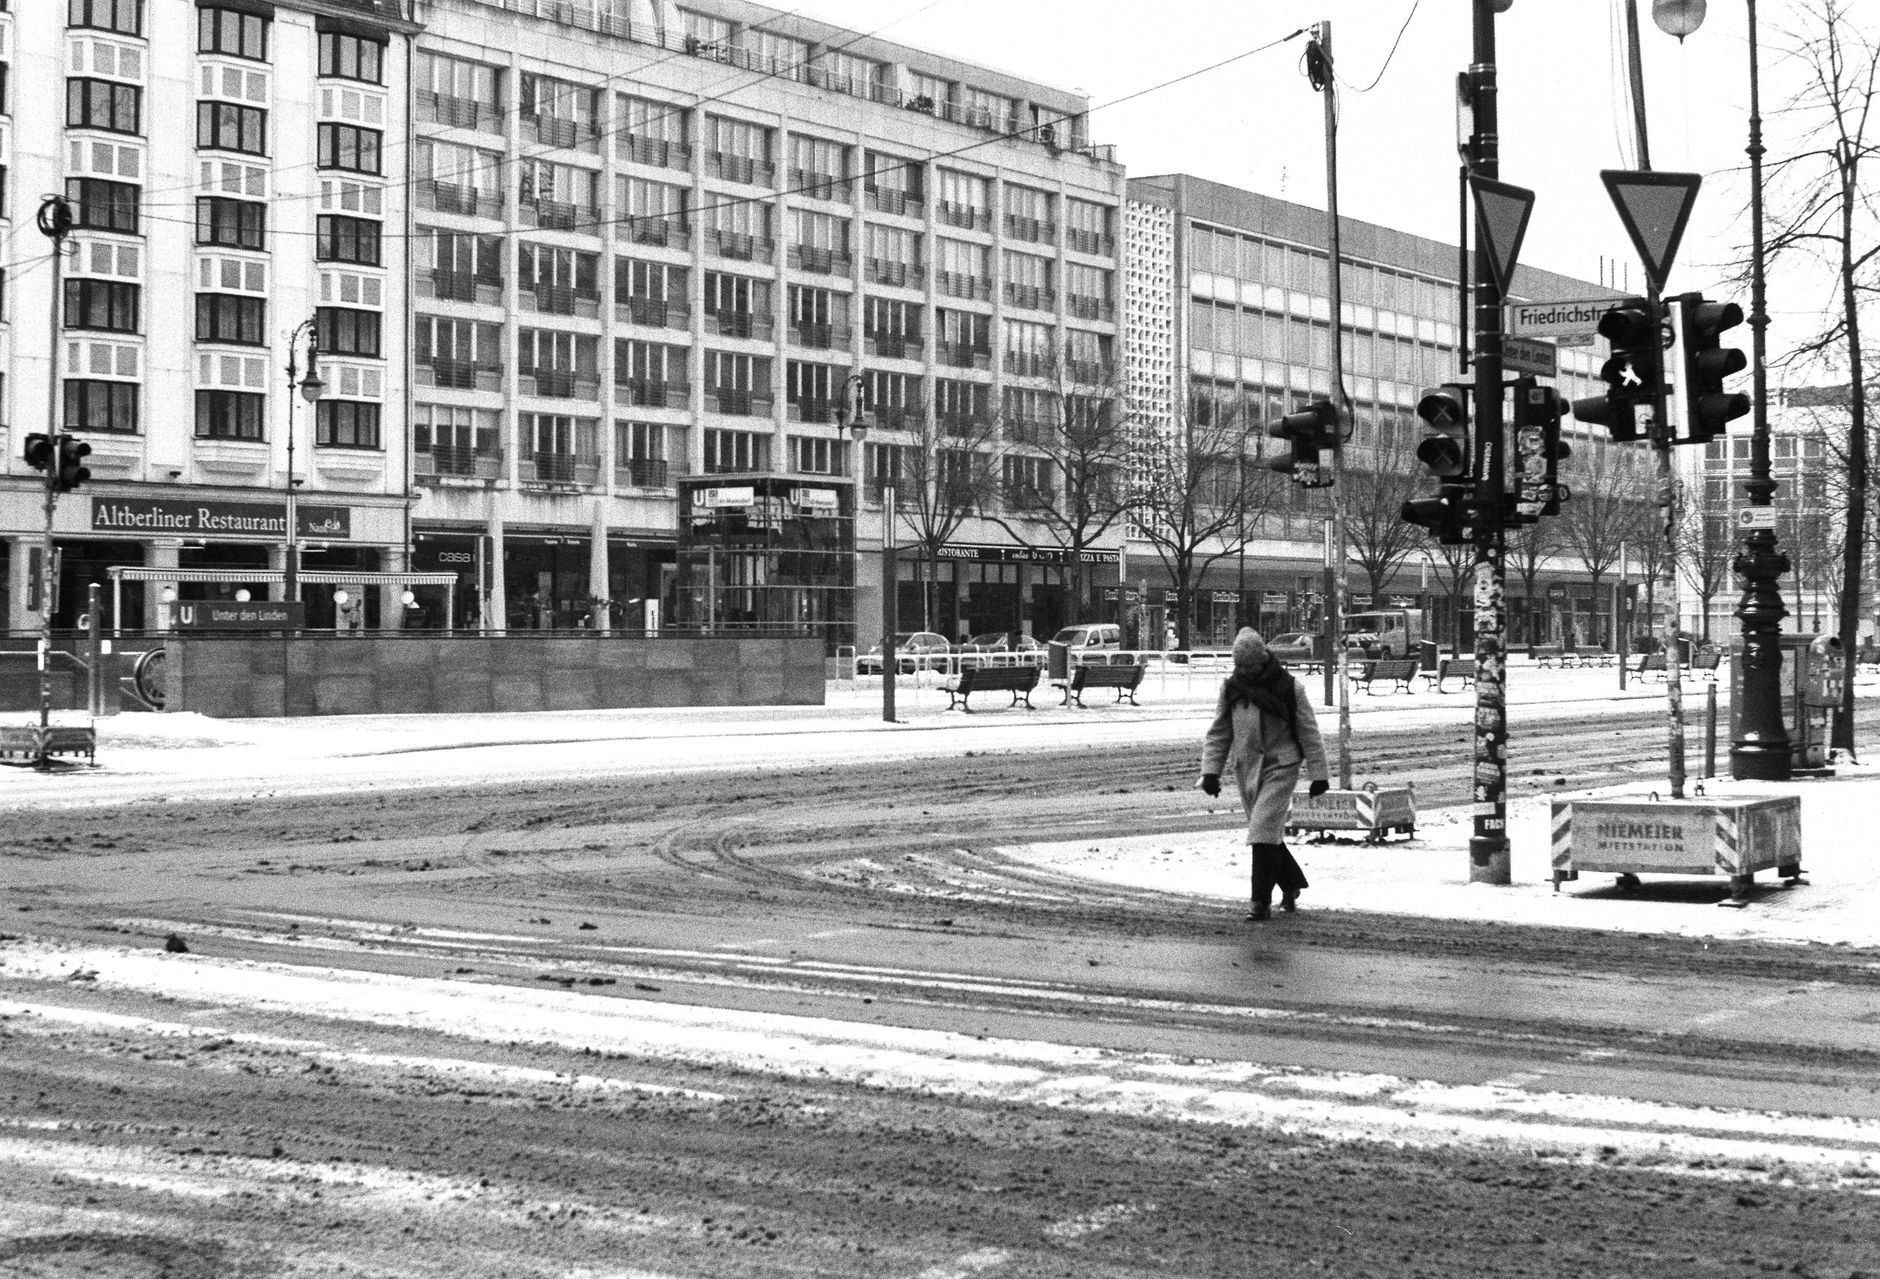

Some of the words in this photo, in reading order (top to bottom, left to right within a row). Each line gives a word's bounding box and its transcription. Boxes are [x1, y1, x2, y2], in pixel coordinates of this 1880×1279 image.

[1520, 303, 1615, 325] Friedrichstr
[693, 490, 704, 506] U
[790, 488, 799, 505] U
[95, 505, 192, 528] Altberliner
[197, 508, 287, 531] Restaurant
[438, 552, 471, 563] casa
[181, 606, 193, 624] U
[212, 609, 238, 621] Unter
[258, 609, 288, 621] Linden
[1597, 822, 1683, 840] NIEMEIER
